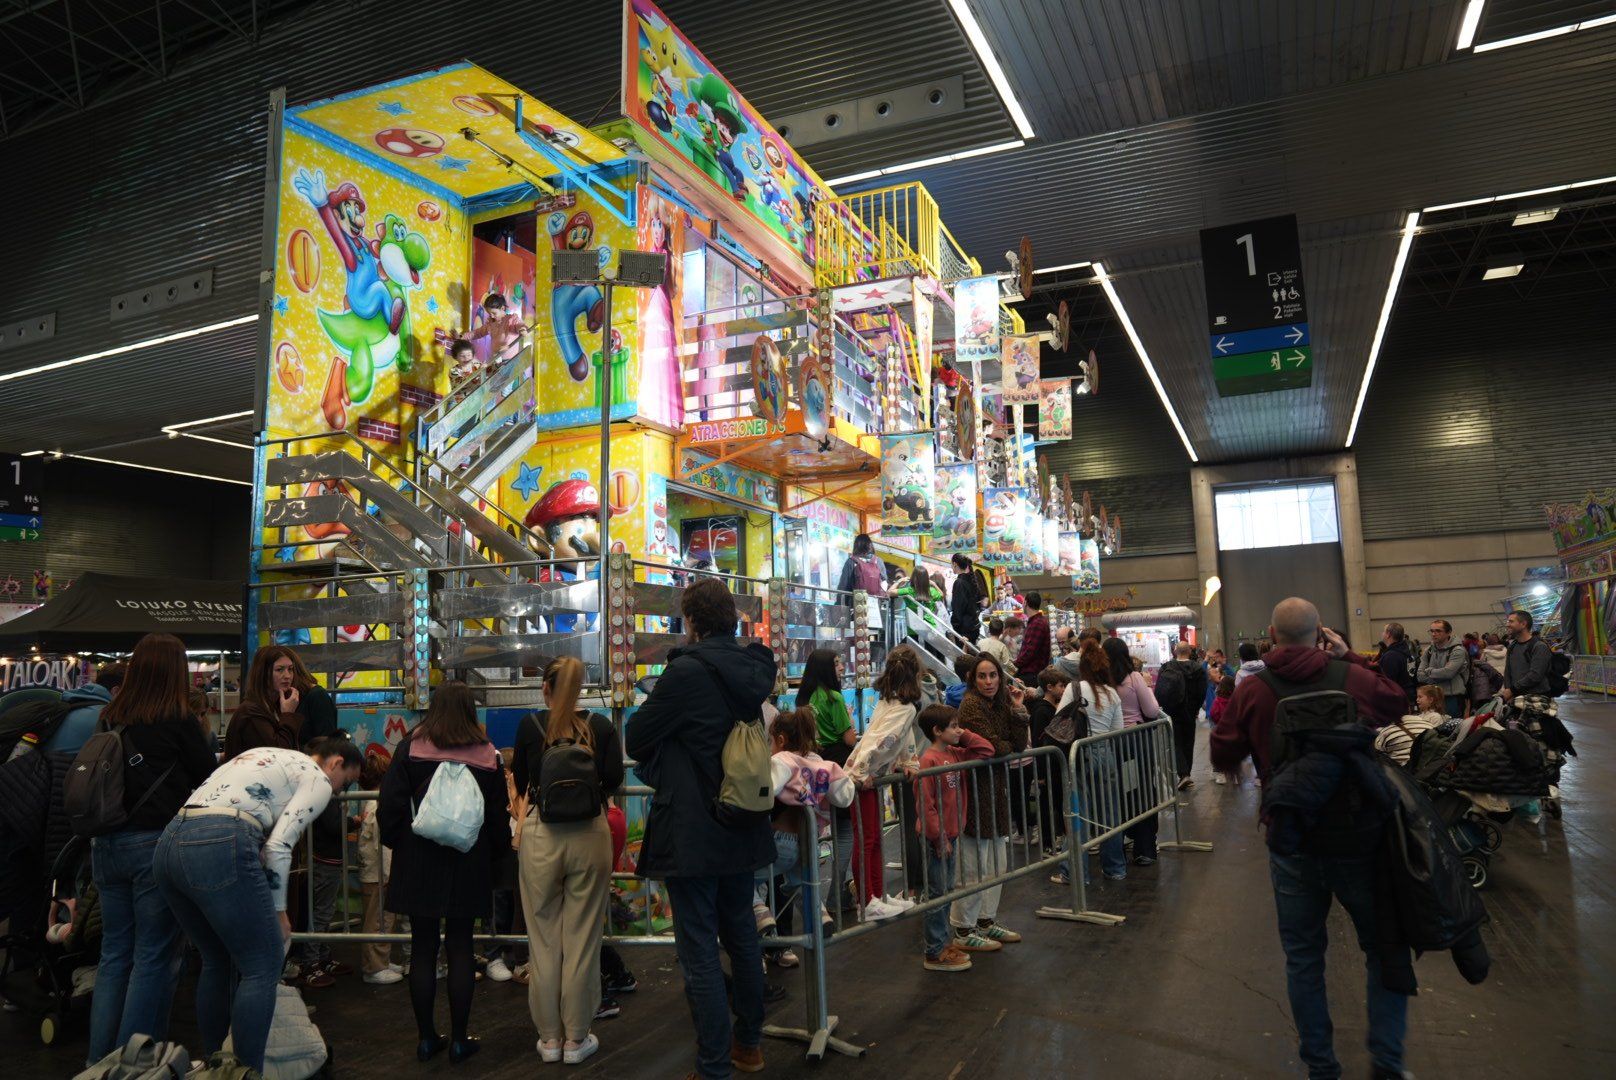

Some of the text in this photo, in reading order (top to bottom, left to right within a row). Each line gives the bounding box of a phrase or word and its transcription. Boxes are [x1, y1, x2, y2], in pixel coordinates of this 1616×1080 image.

[1236, 233, 1256, 276] 1
[1273, 306, 1282, 319] 2
[690, 419, 768, 443] ATRACCIONES
[11, 461, 20, 485] 1
[116, 600, 187, 609] LOIUKO
[2, 660, 73, 692] TALOAK
[385, 716, 407, 740] M
